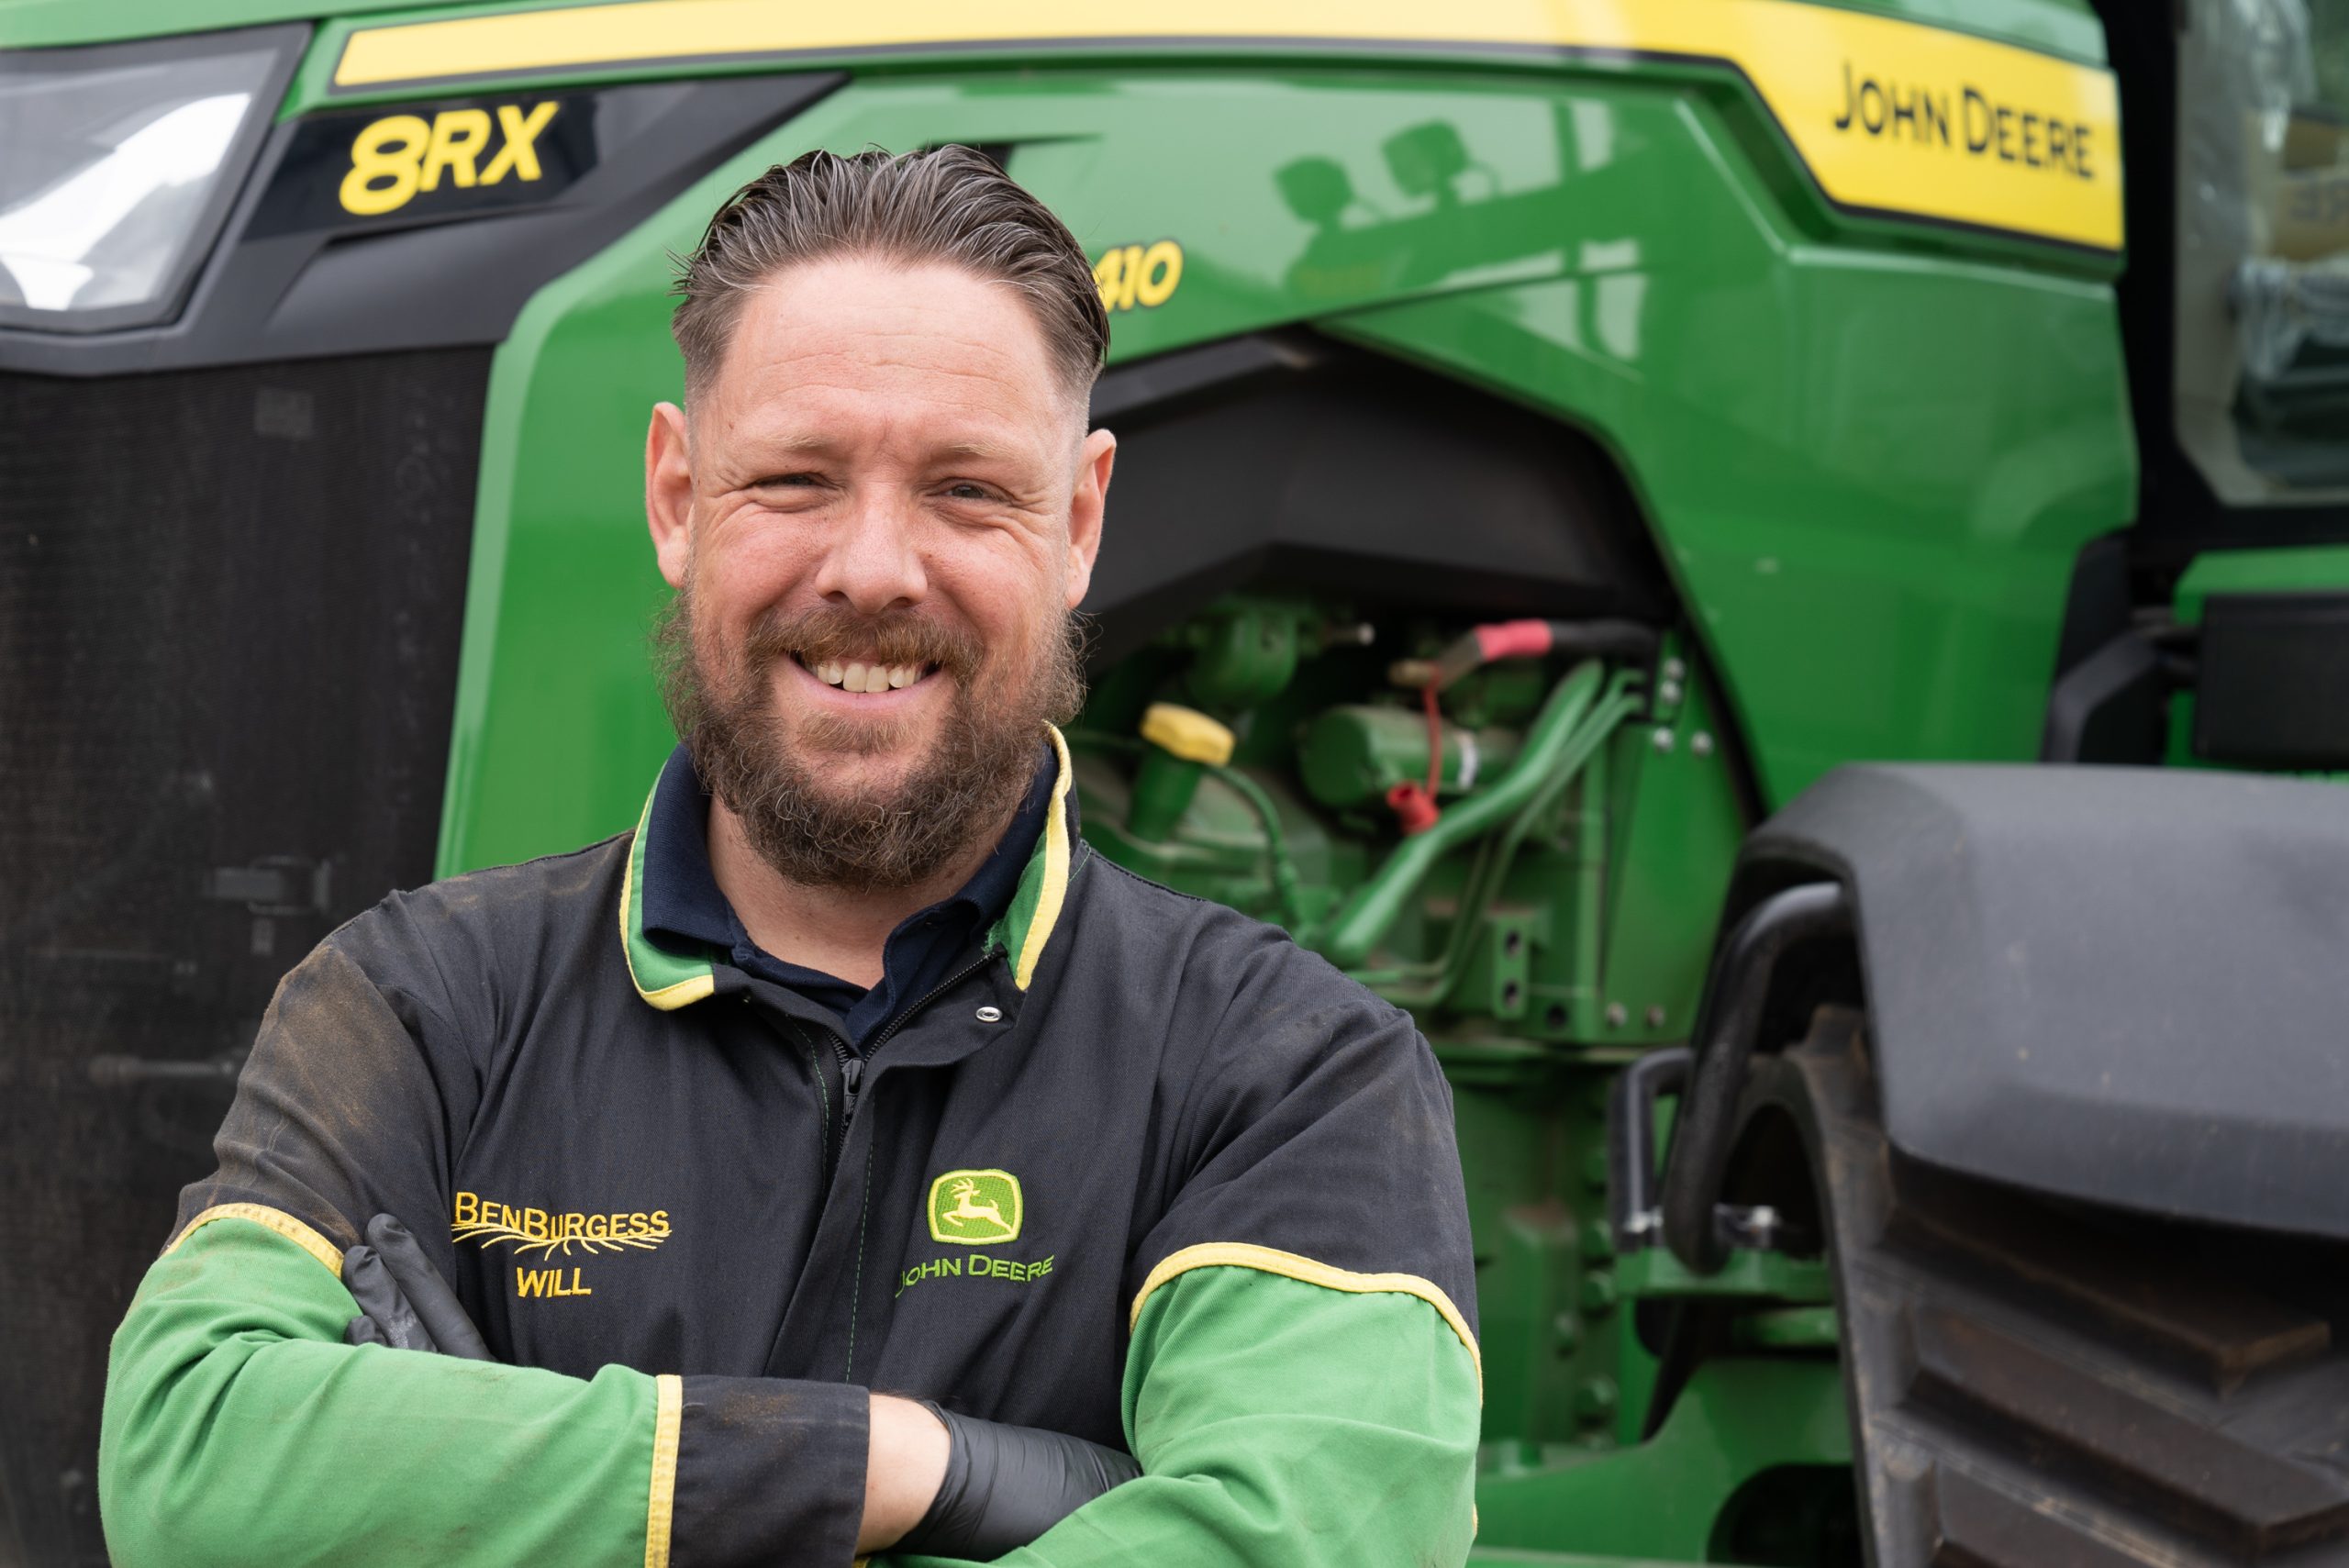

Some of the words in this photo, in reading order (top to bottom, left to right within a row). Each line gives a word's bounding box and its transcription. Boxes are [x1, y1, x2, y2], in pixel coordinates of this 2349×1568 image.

[339, 101, 560, 216] 8RX
[1833, 61, 1950, 149] JOHN
[1962, 85, 2095, 180] DEERE
[517, 1267, 592, 1298] WILL
[895, 1258, 962, 1298] JOHN
[969, 1253, 1055, 1282] DEERE
